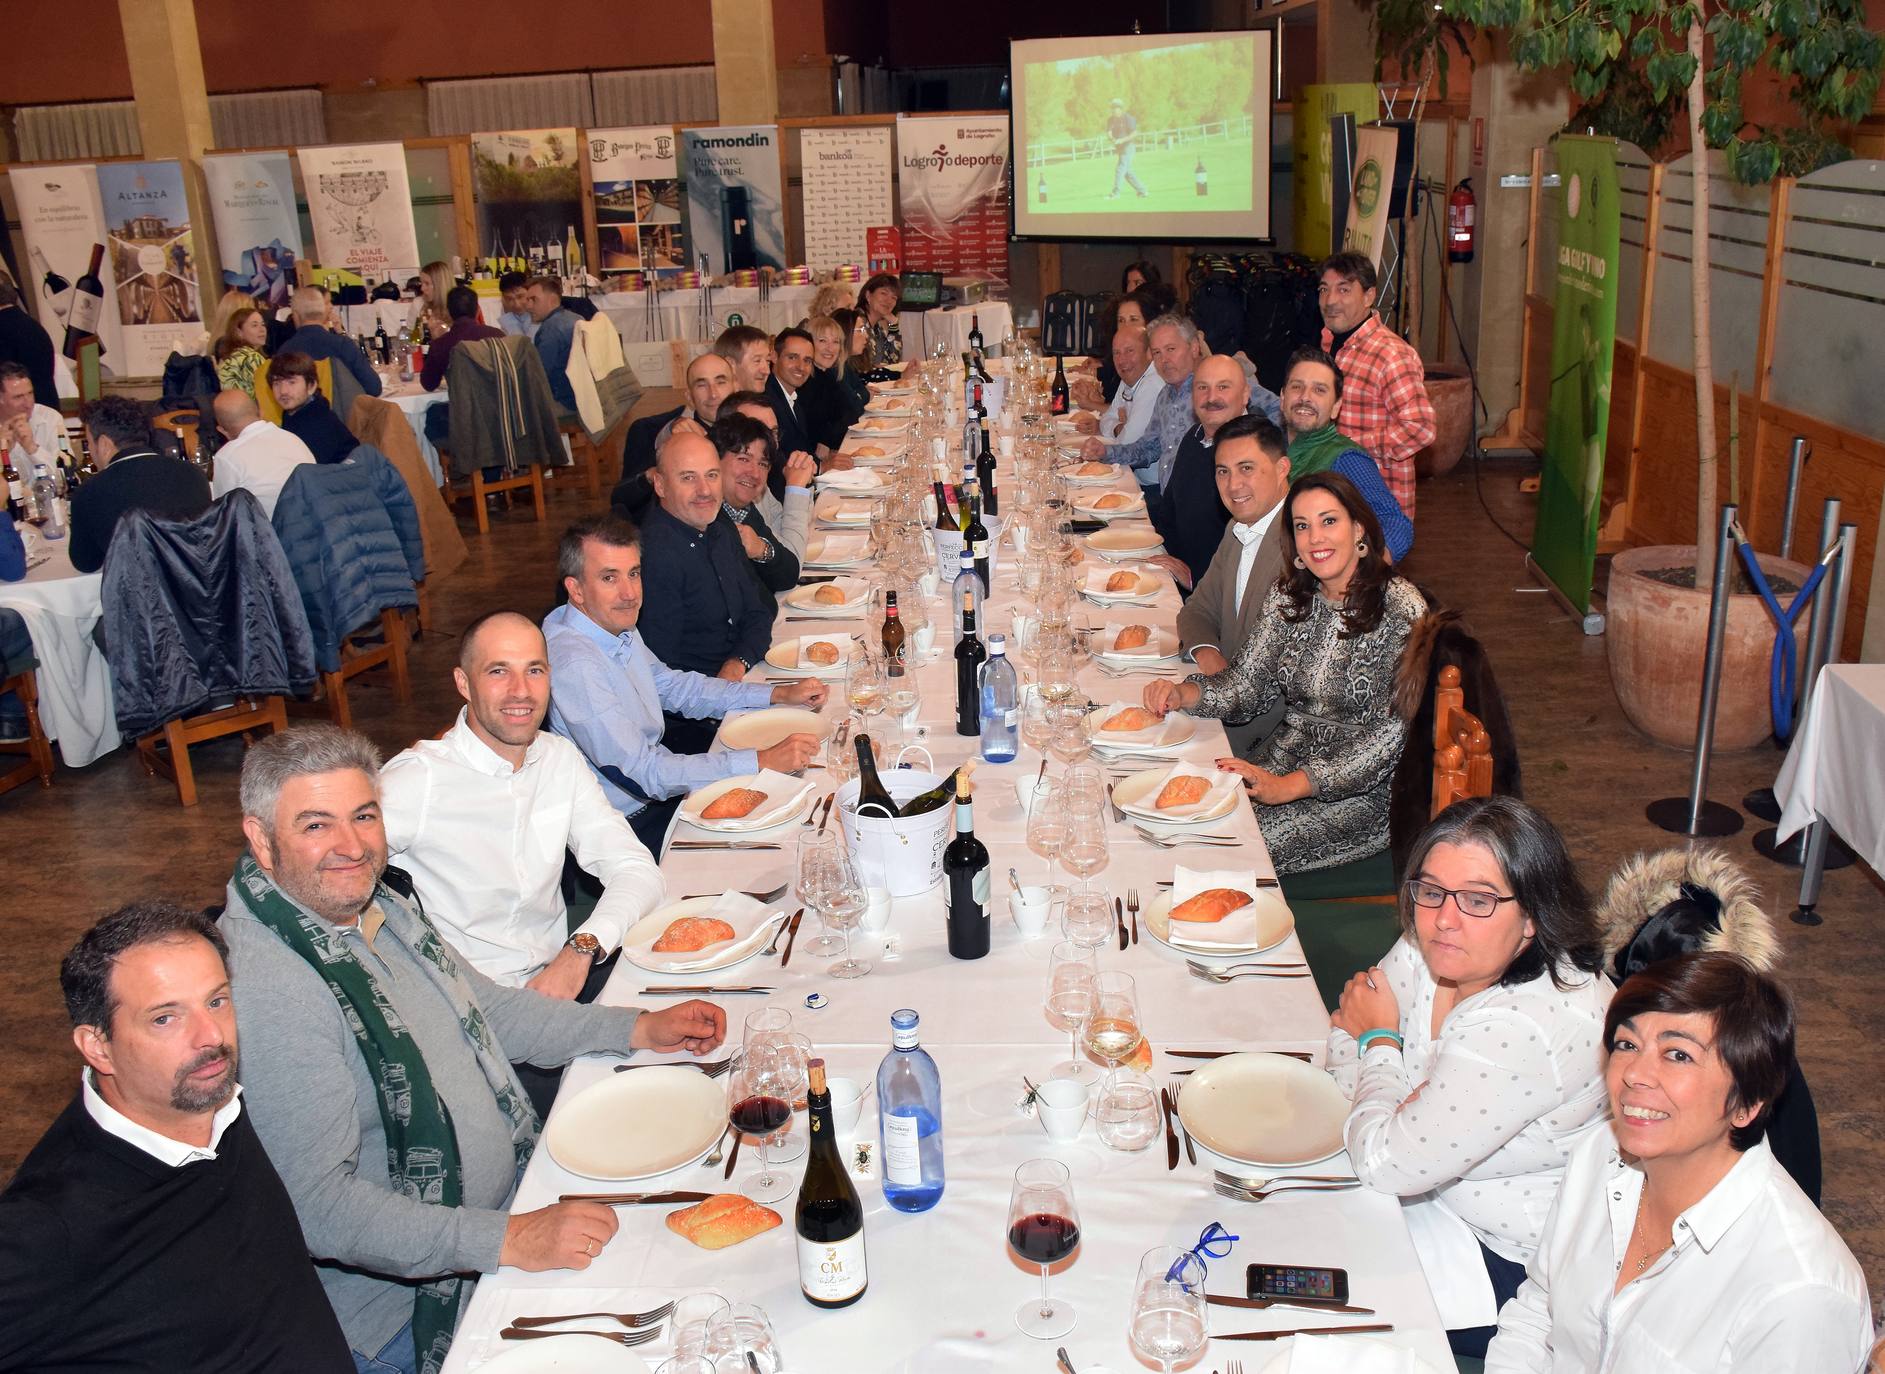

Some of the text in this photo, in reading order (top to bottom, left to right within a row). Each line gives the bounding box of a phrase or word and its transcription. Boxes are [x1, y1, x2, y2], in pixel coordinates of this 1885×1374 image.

[692, 133, 770, 149] ramondin
[819, 150, 853, 160] bankoa
[694, 157, 742, 167] Pure care.
[695, 167, 745, 177] Pure trust.
[118, 190, 168, 200] ALTANZA
[360, 248, 383, 256] VIAJE
[346, 256, 389, 264] COMIENZA
[821, 1262, 842, 1273] CM
